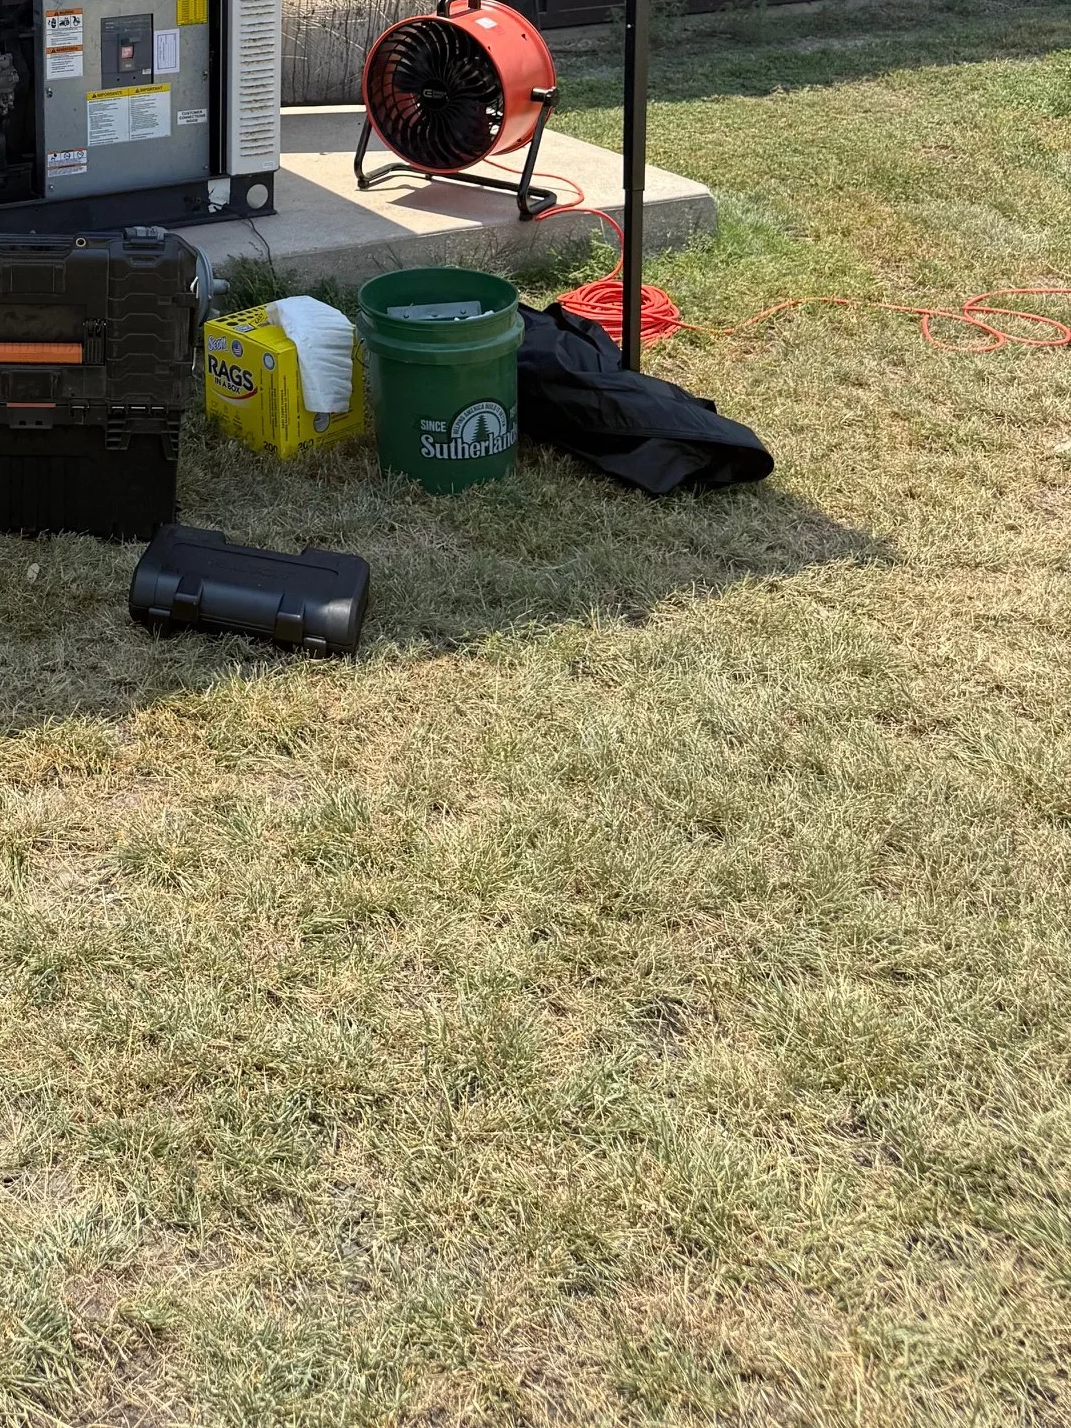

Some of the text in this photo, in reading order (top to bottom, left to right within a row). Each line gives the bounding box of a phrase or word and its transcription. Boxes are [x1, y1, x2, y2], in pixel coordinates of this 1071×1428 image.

[207, 354, 254, 392] RAGS
[214, 376, 222, 385] IN
[227, 382, 241, 394] BOX
[420, 419, 447, 432] SINCE
